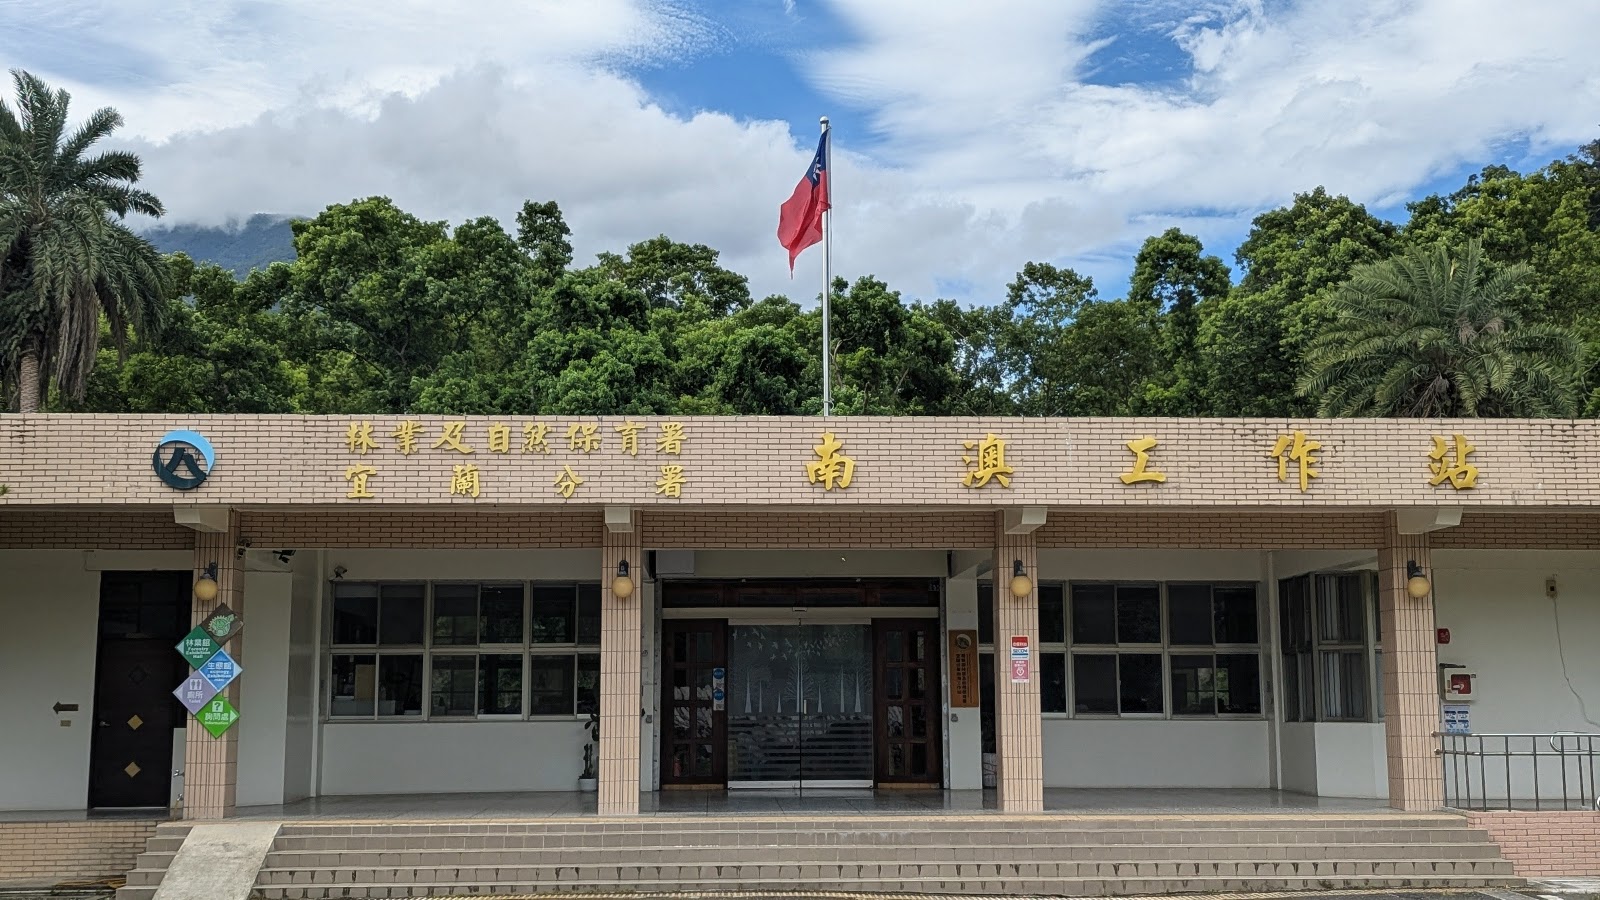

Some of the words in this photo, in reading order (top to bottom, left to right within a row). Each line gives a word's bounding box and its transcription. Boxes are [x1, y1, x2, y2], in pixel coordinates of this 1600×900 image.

[344, 420, 688, 456] 林業及自然保育署
[805, 430, 1480, 494] 南澳工作站
[344, 463, 687, 499] 宜蘭分署
[186, 638, 210, 647] 林業館
